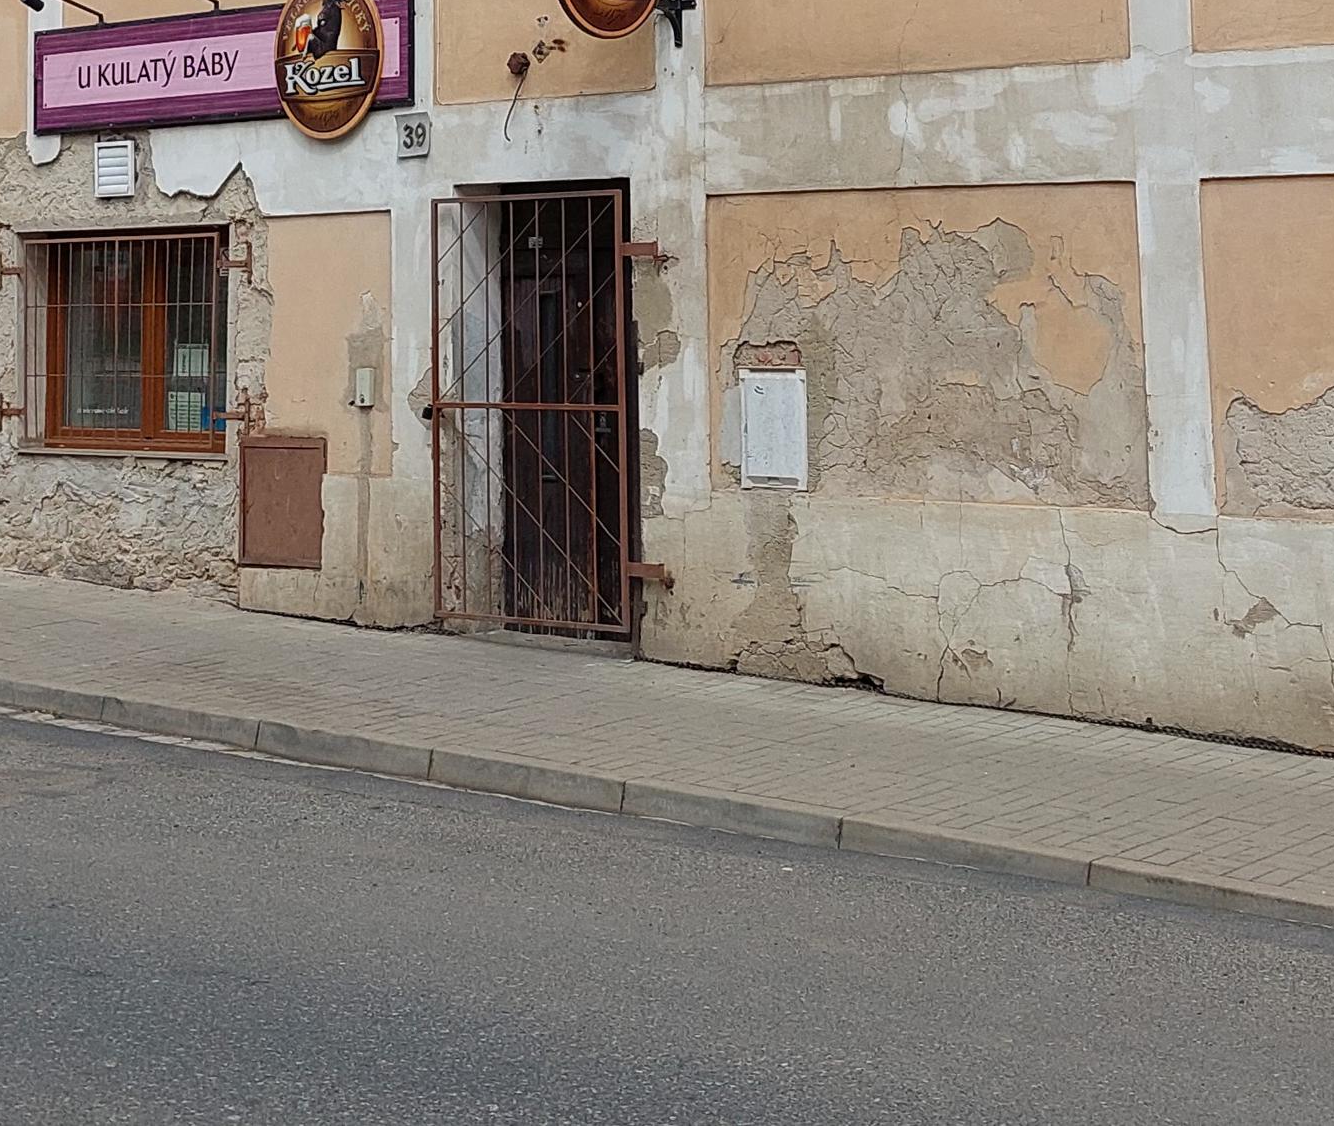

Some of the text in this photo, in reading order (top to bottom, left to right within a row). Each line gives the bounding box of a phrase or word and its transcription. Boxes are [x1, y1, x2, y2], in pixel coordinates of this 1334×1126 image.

[78, 46, 239, 89] U KULATÝ BÁBY
[284, 57, 365, 95] Kozel
[403, 122, 427, 149] 39
